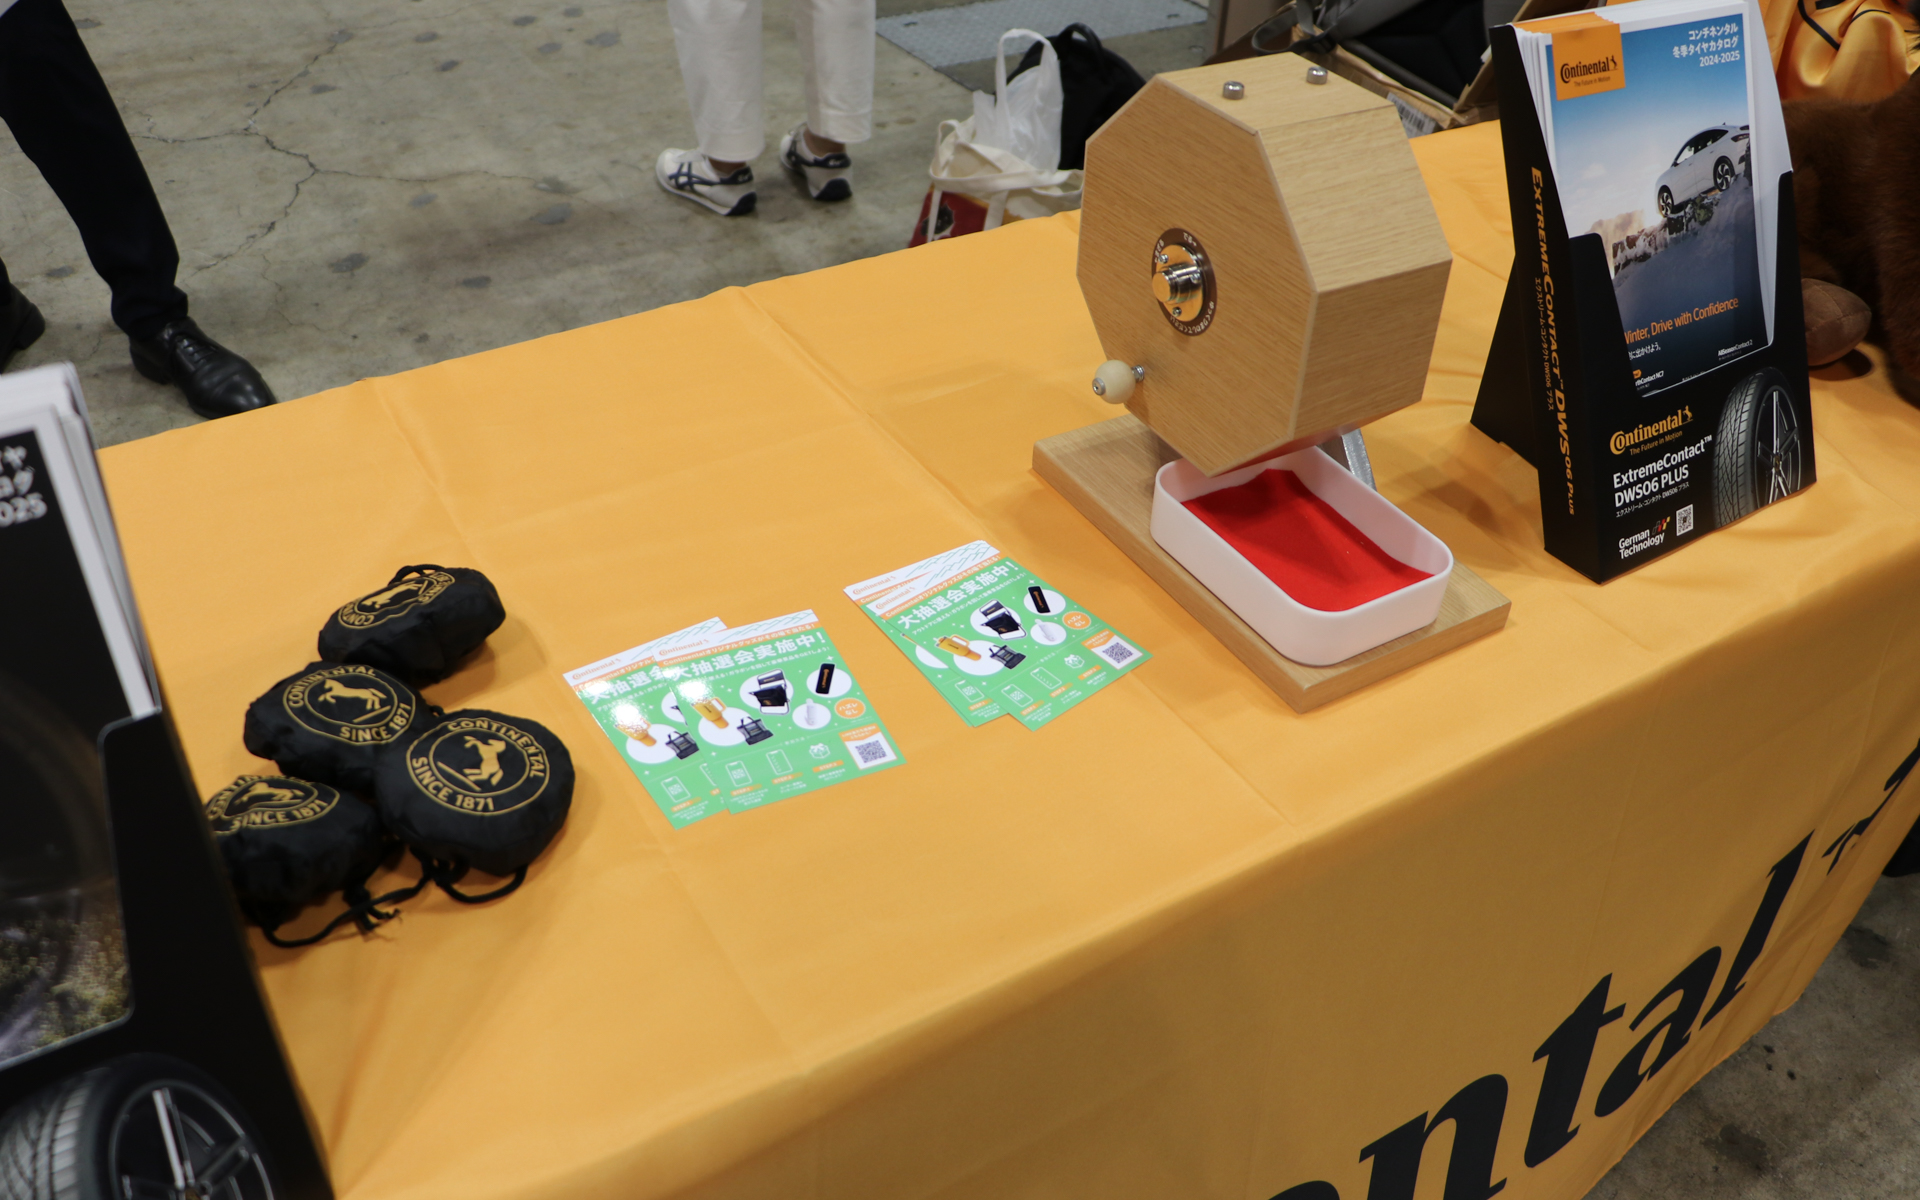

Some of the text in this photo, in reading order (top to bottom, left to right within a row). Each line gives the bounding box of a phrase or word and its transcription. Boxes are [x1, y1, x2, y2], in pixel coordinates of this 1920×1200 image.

[1688, 22, 1739, 40] コンチネンタル
[1672, 35, 1739, 58] 冬季タイヤカタログ
[1699, 50, 1740, 67] 2024-2025
[1560, 56, 1610, 84] Continental
[1651, 319, 1673, 336] Drive
[1674, 311, 1693, 328] with
[1693, 297, 1739, 321] Confidence
[1544, 362, 1552, 388] DWS06
[1609, 409, 1682, 455] Continental
[1630, 447, 1640, 455] The
[1641, 441, 1658, 452] Future
[1665, 430, 1683, 442] Motion
[1614, 464, 1689, 507] DWS06 PLUS
[1662, 486, 1678, 498] DWS06
[1619, 529, 1650, 549] German
[1619, 532, 1665, 559] Technology
[852, 577, 891, 595] Continental
[875, 589, 910, 609] Continental
[898, 561, 1019, 629] 大抽選会実施中!
[1067, 615, 1082, 624] ハズレ
[659, 640, 703, 656] Continental
[673, 631, 826, 682] 大抽選会実施中!
[572, 660, 615, 680] Continental
[839, 703, 858, 711] ハズレ
[340, 702, 411, 741] SINCE 1871
[447, 720, 545, 778] CONTINENTAL
[412, 757, 494, 811] SINCE 1871
[229, 799, 328, 829] SINCE 1871
[1267, 829, 1815, 1200] ntal
